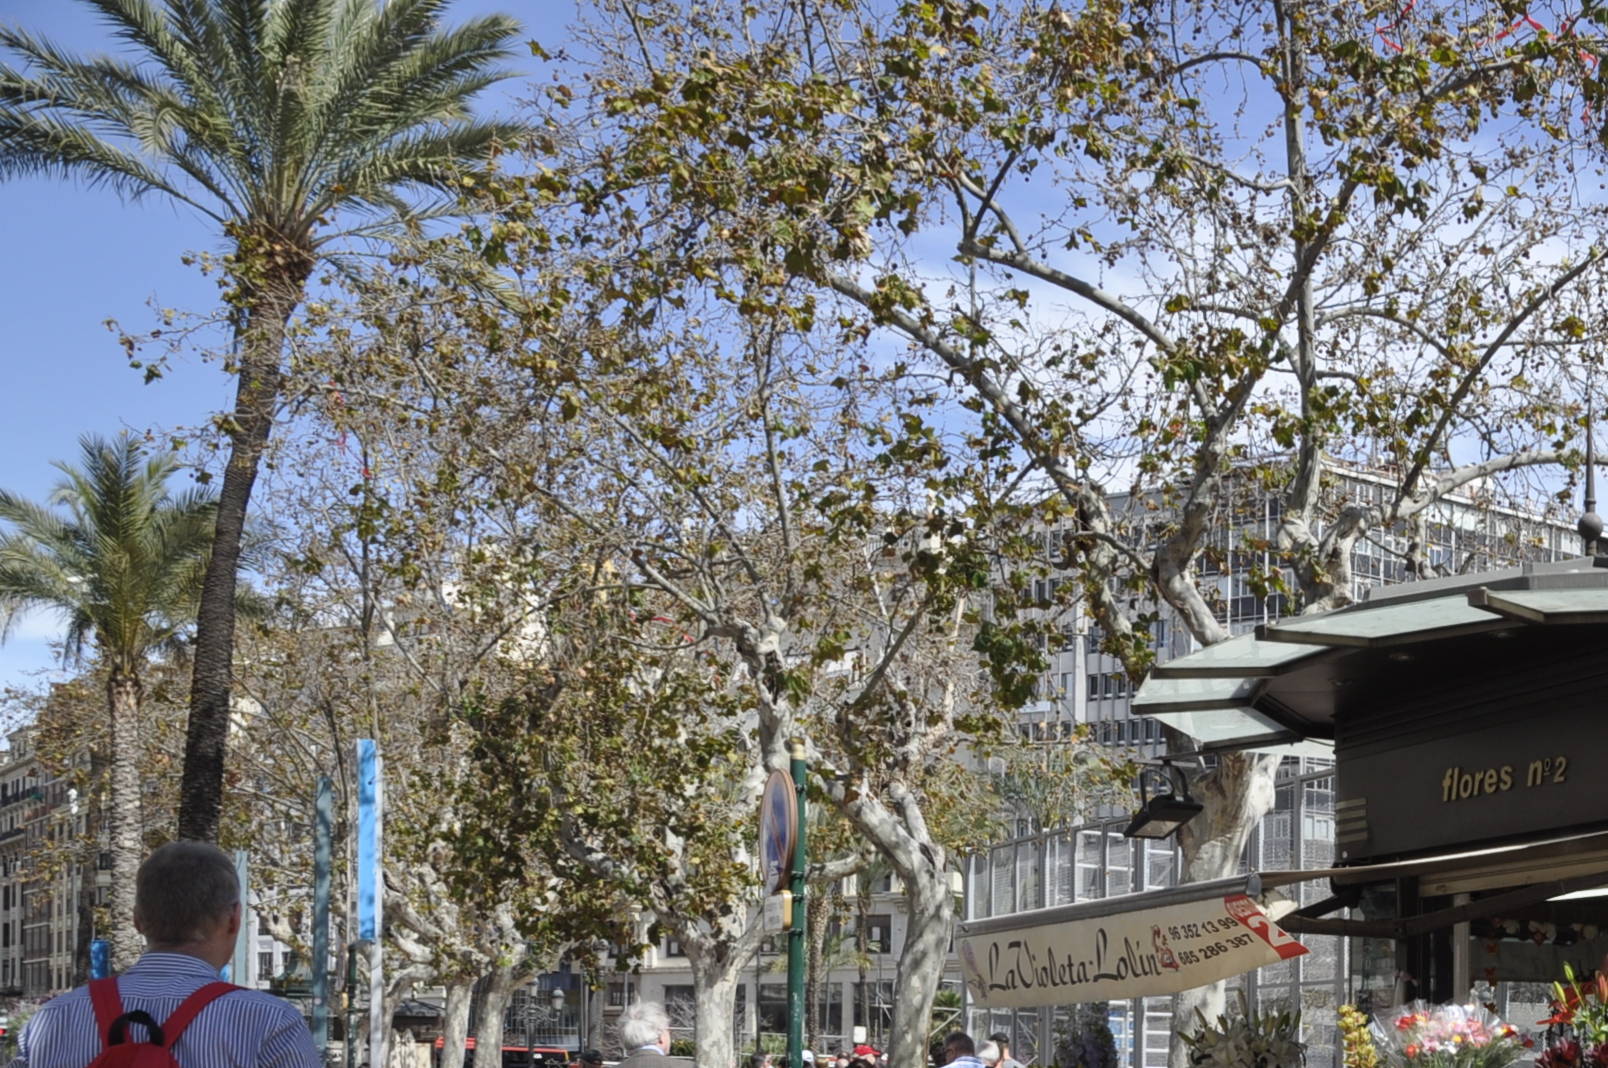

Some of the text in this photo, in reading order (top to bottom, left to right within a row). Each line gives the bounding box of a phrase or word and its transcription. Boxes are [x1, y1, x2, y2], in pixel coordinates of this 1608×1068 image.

[1442, 765, 1513, 802] flores
[1168, 917, 1239, 941] 96 352 13 99
[1247, 915, 1295, 947] 2
[1178, 933, 1255, 965] 685 286 387
[988, 942, 1018, 991] La
